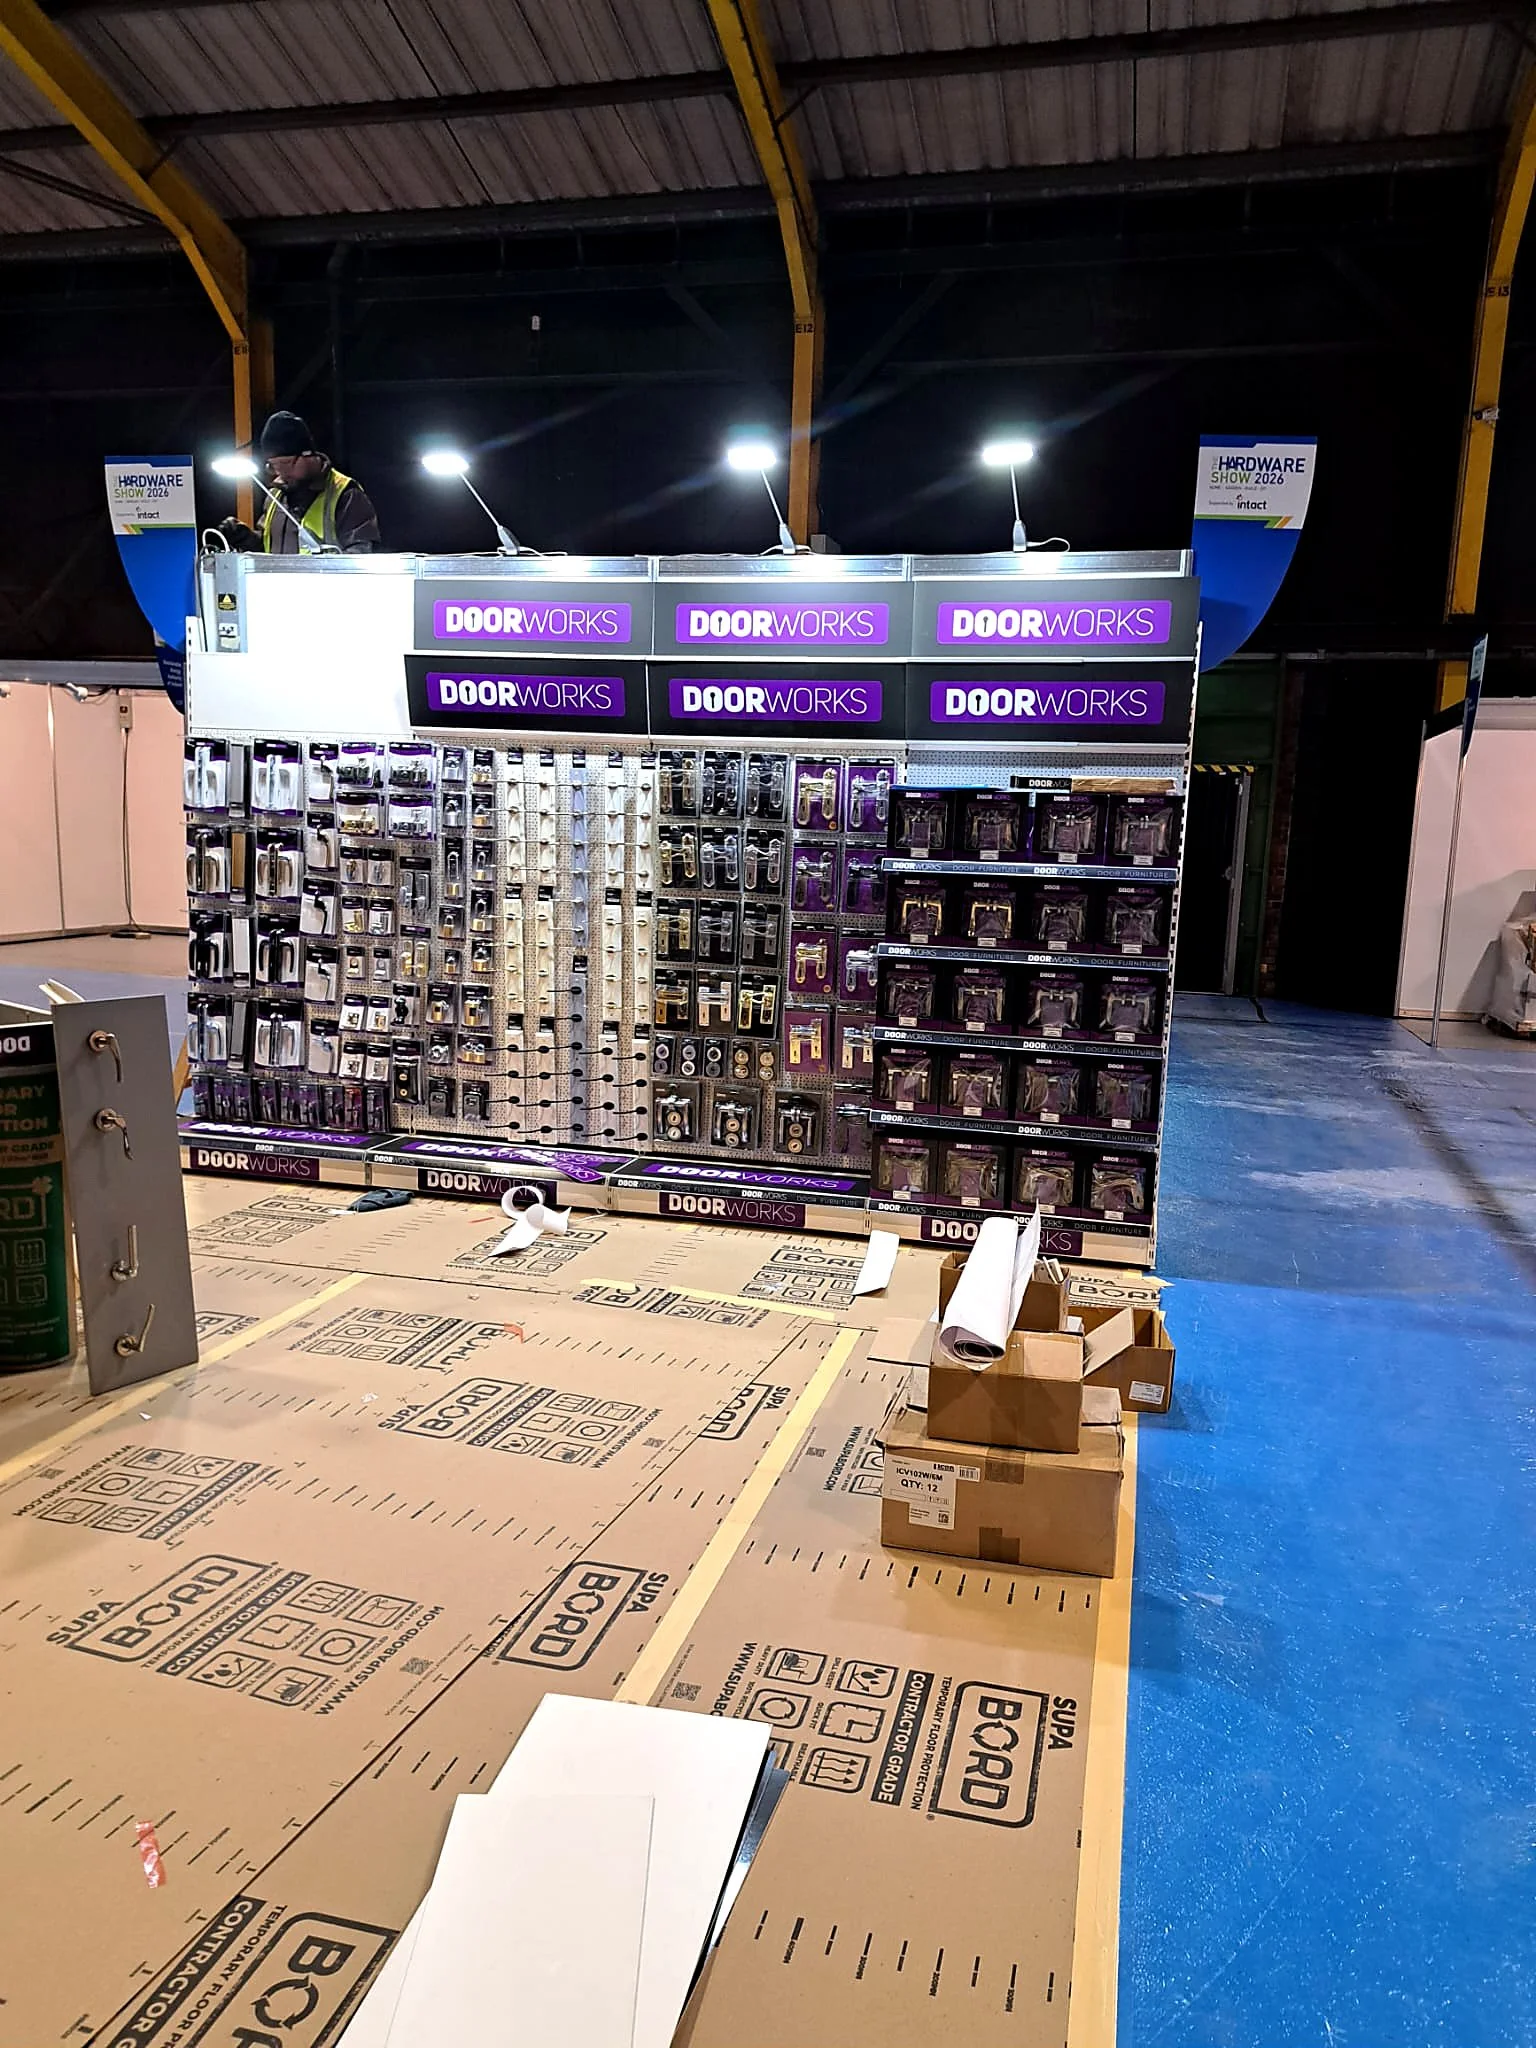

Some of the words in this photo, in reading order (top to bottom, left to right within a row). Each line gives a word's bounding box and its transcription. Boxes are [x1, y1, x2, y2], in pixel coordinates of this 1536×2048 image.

[795, 323, 814, 333] E12
[1211, 471, 1251, 483] SHOW
[1254, 472, 1284, 485] 2026
[1218, 456, 1305, 473] HARDWARE
[114, 488, 144, 498] SHOW
[147, 488, 169, 498] 2026
[118, 474, 183, 487] HARDWARE
[137, 511, 160, 519] intact
[1237, 500, 1267, 510] intact
[446, 606, 619, 636] DOORWORKS
[689, 610, 874, 638] DOORWORKS
[952, 608, 1155, 637] DOORWORKS
[439, 679, 612, 709] DOORWORKS
[683, 686, 867, 714] DOORWORKS
[946, 688, 1148, 717] DOORWORKS
[893, 861, 942, 871] DOORWORKS
[1034, 867, 1086, 876] DOORWORKS
[888, 947, 937, 957] DOORWORKS
[1028, 954, 1080, 964] DOORWORKS
[884, 1031, 933, 1041] DOORWORKS
[1023, 1041, 1075, 1051] DOORWORKS
[188, 1122, 355, 1143] DOORWORKS
[880, 1113, 929, 1125] DOORWORKS
[1018, 1126, 1069, 1136] DOORWORKS
[198, 1149, 311, 1176] DOORWORKS
[657, 1165, 839, 1189] DOORWORKS
[617, 1179, 662, 1190] DOORWORKS
[741, 1189, 787, 1200] DOORWORKS
[668, 1194, 796, 1223] DOORWORKS
[878, 1202, 926, 1214] DOORWORKS
[781, 1244, 823, 1253] SUPA
[418, 1383, 503, 1432] BORD
[763, 1386, 791, 1410] SUPA
[378, 1403, 424, 1430] SUPA
[591, 1408, 664, 1469] WWW.SUPABORD.COM
[900, 1478, 924, 1490] QTY:
[927, 1483, 938, 1493] 12
[100, 1565, 239, 1648] BORD
[626, 1571, 670, 1613] SUPA
[45, 1600, 124, 1645] SUPA
[141, 1627, 199, 1669] TEMPORARY
[200, 1604, 233, 1628] FLOOR
[231, 1567, 284, 1607] PROTECTION
[166, 1604, 262, 1673] CONTRACTOR
[259, 1574, 305, 1606] GRADE
[530, 1571, 621, 1659] BORD
[315, 1605, 446, 1716] WWW.SUPABORD.COM
[302, 1692, 322, 1711] HEAVY
[321, 1678, 339, 1693] DUTY
[932, 1676, 953, 1724] TEMPORARY
[891, 1673, 926, 1753] CONTRACTOR
[1047, 1696, 1077, 1750] SUPA
[924, 1723, 941, 1753] FLOOR
[959, 1695, 1023, 1810] BORD
[877, 1755, 904, 1803] GRADE
[910, 1752, 934, 1810] PROTECTION
[219, 1904, 288, 1982] TEMPORARY
[130, 1900, 254, 2034] CONTRACTOR
[177, 1982, 223, 2030] FLOOR
